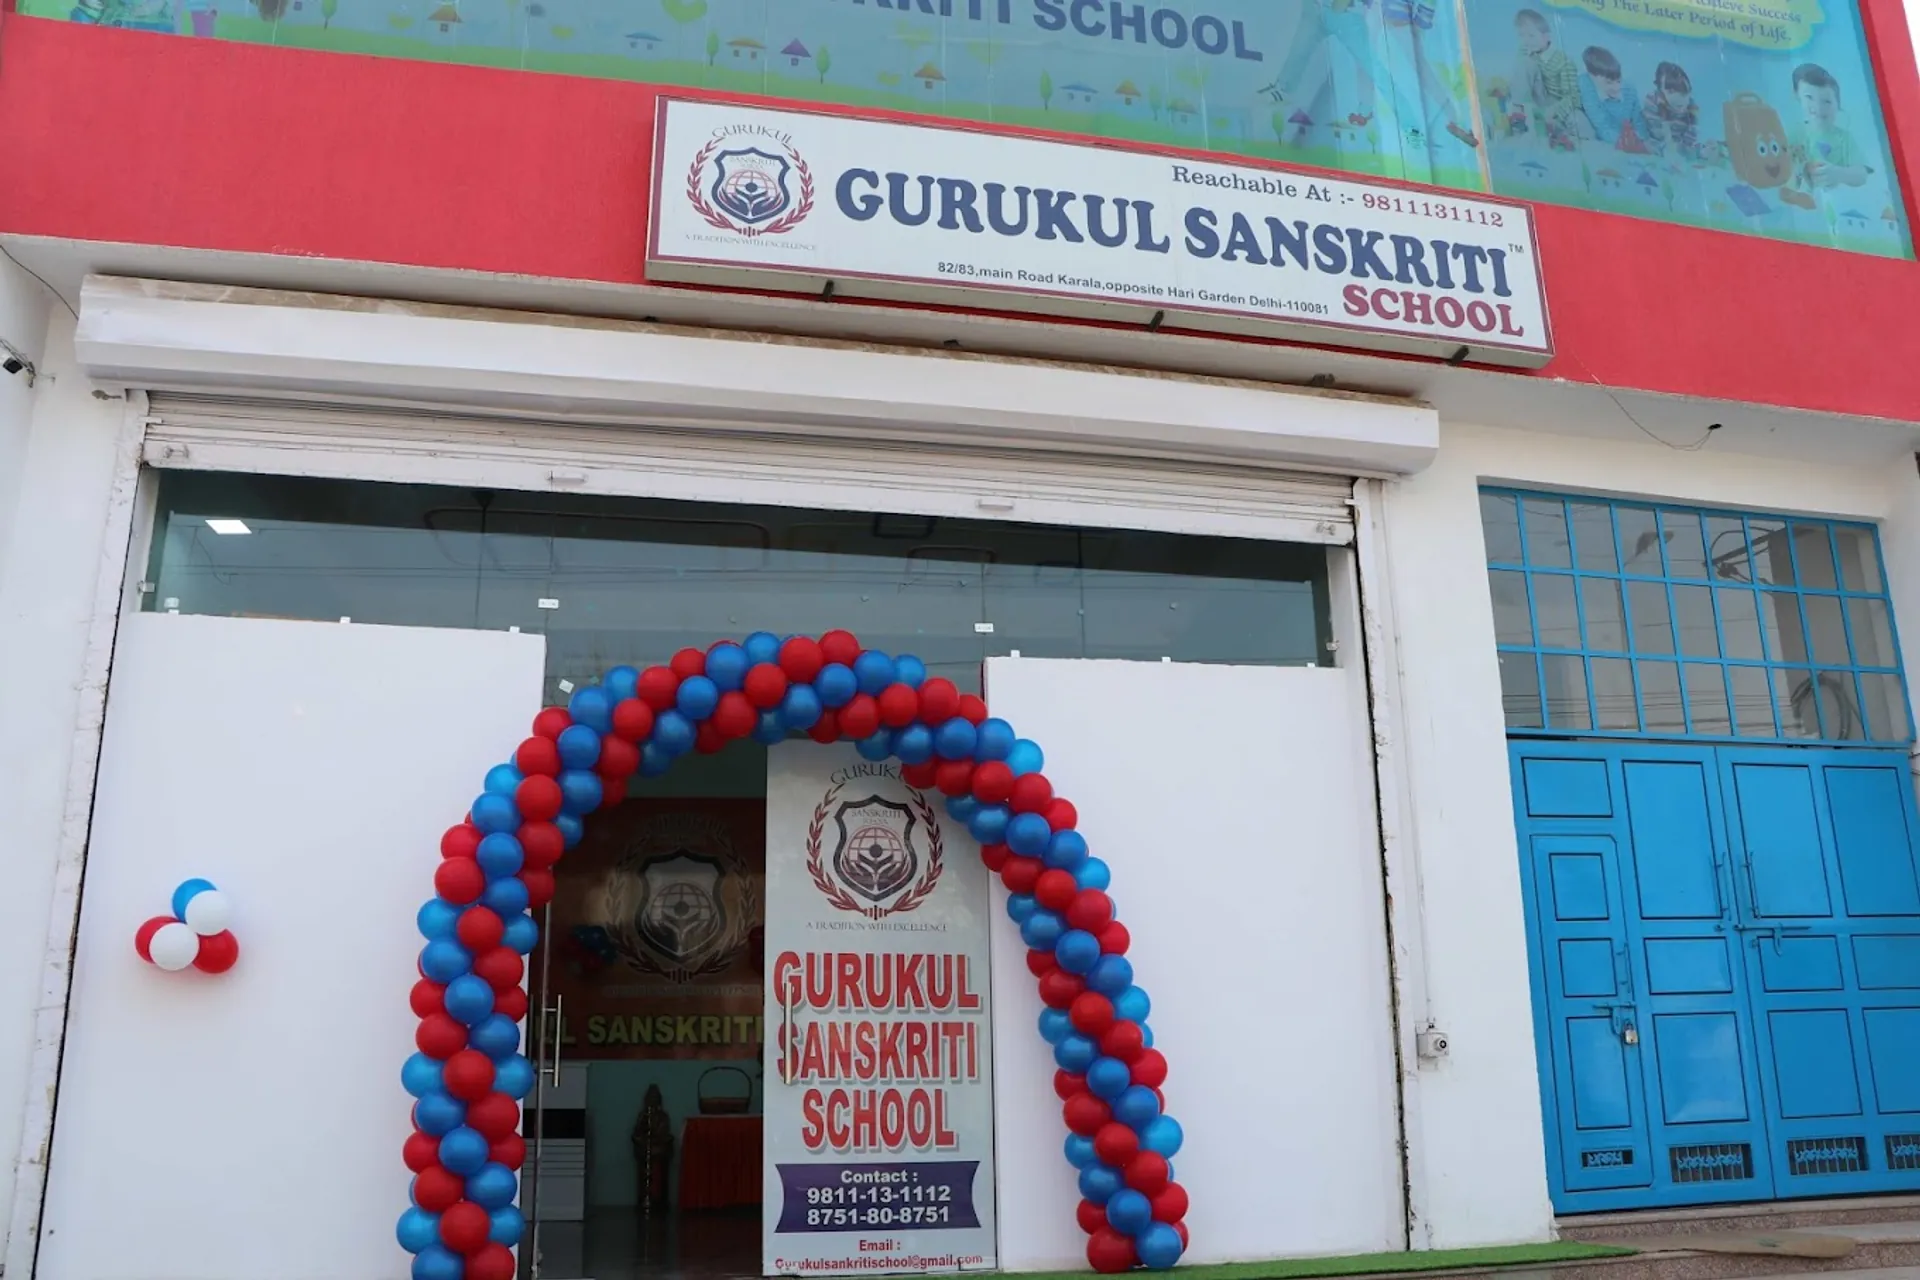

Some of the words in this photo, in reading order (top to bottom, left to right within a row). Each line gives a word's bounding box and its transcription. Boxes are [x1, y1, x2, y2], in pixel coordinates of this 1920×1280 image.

[1644, 3, 1684, 21] Later
[1689, 11, 1736, 31] Period
[1741, 20, 1756, 39] of
[1749, 3, 1801, 23] Success
[1033, 0, 1263, 62] SCHOOL
[712, 124, 792, 144] GURUKUL
[1172, 165, 1297, 198] Reachable
[1305, 184, 1332, 203] At
[1362, 193, 1504, 228] 9811131112
[835, 168, 1171, 254] GURUKUL
[1184, 207, 1513, 297] SANSKRITI
[937, 261, 1014, 280] 82/83,main
[1018, 269, 1054, 284] Road
[1058, 274, 1164, 298] Karala,opposite
[1168, 285, 1195, 300] Hari
[1198, 289, 1246, 305] Garden
[1249, 295, 1329, 316] Delhi-110081
[1342, 284, 1525, 337] SCHOOL
[830, 763, 904, 786] GURUK
[815, 922, 865, 931] TRADITION
[868, 922, 892, 932] WITH
[894, 922, 948, 932] EXCELLENCE
[774, 951, 980, 1009] GURUKUL
[588, 1014, 764, 1045] SANSKRITI
[777, 1021, 977, 1081] SANSKRITI
[802, 1088, 955, 1149] SCHOOL
[841, 1170, 908, 1184] Contact
[807, 1186, 951, 1205] 9811-13-1112
[807, 1206, 949, 1226] 8751-80-8751
[859, 1239, 893, 1252] Email
